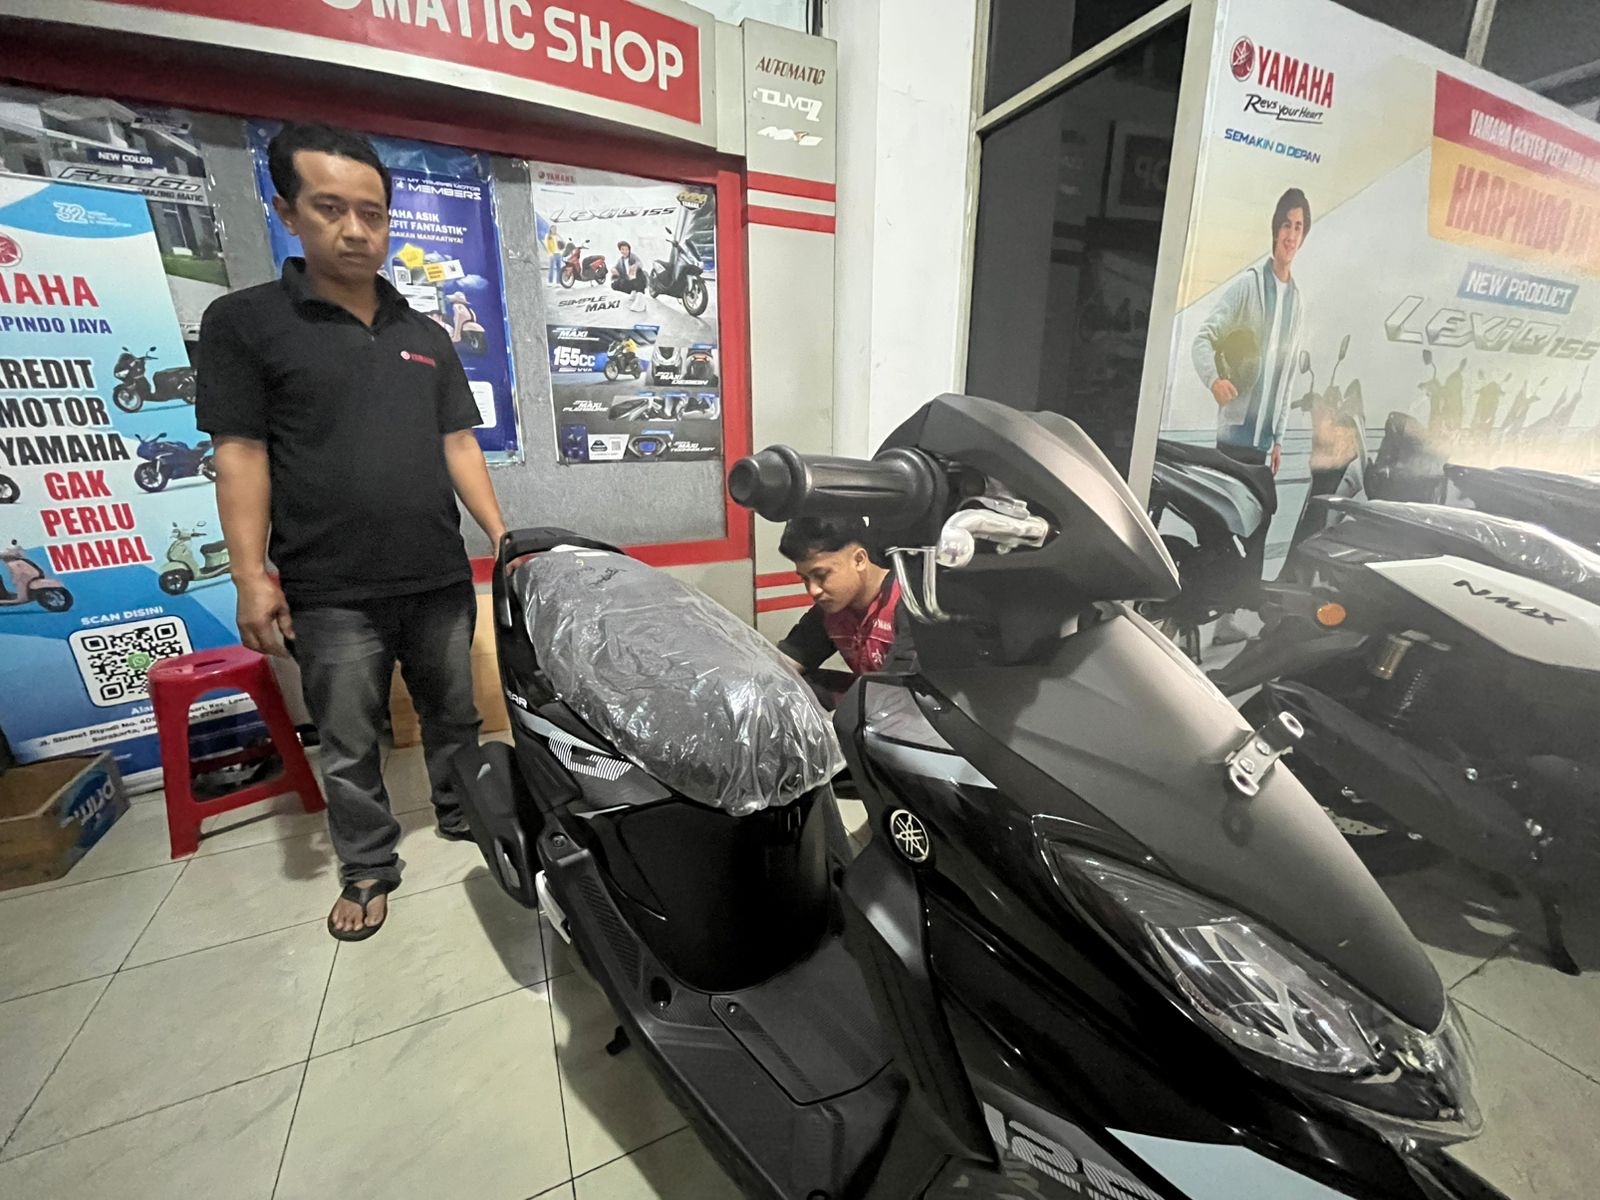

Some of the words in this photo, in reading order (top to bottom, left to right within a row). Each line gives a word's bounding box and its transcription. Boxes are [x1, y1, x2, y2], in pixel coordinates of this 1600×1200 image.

[320, 0, 535, 50] ATIC
[543, 6, 684, 91] SHOP
[755, 56, 826, 86] AUTOMATIC
[1257, 46, 1335, 108] YAMAHA
[1243, 93, 1278, 113] Revs
[1300, 105, 1324, 121] Heart
[1469, 109, 1512, 150] YAMAHA
[98, 151, 120, 162] NEW
[122, 154, 155, 165] COLOR
[1224, 128, 1274, 151] SEMAKIN
[1275, 142, 1287, 155] DI
[1286, 145, 1321, 164] DEPAN
[140, 187, 174, 199] MAZING
[177, 192, 204, 202] MATIC
[408, 183, 482, 201] MEMBERS
[388, 208, 414, 220] AHA
[415, 211, 440, 223] ASIK
[641, 206, 678, 217] 155
[558, 295, 608, 307] SIMPLE
[1465, 269, 1507, 297] NEW
[1506, 278, 1572, 309] PRODUCT
[585, 300, 621, 313] MAXI
[0, 316, 65, 333] PINDO
[71, 318, 113, 334] JAYA
[1547, 335, 1600, 361] 155
[0, 358, 96, 389] REDIT
[0, 397, 110, 428] MOTOR
[0, 433, 131, 466] YAMAHA
[44, 470, 112, 501] GAK
[40, 503, 136, 537] PERLU
[47, 536, 153, 572] MAHAL
[80, 613, 121, 626] SCAN
[122, 606, 164, 619] DISINI
